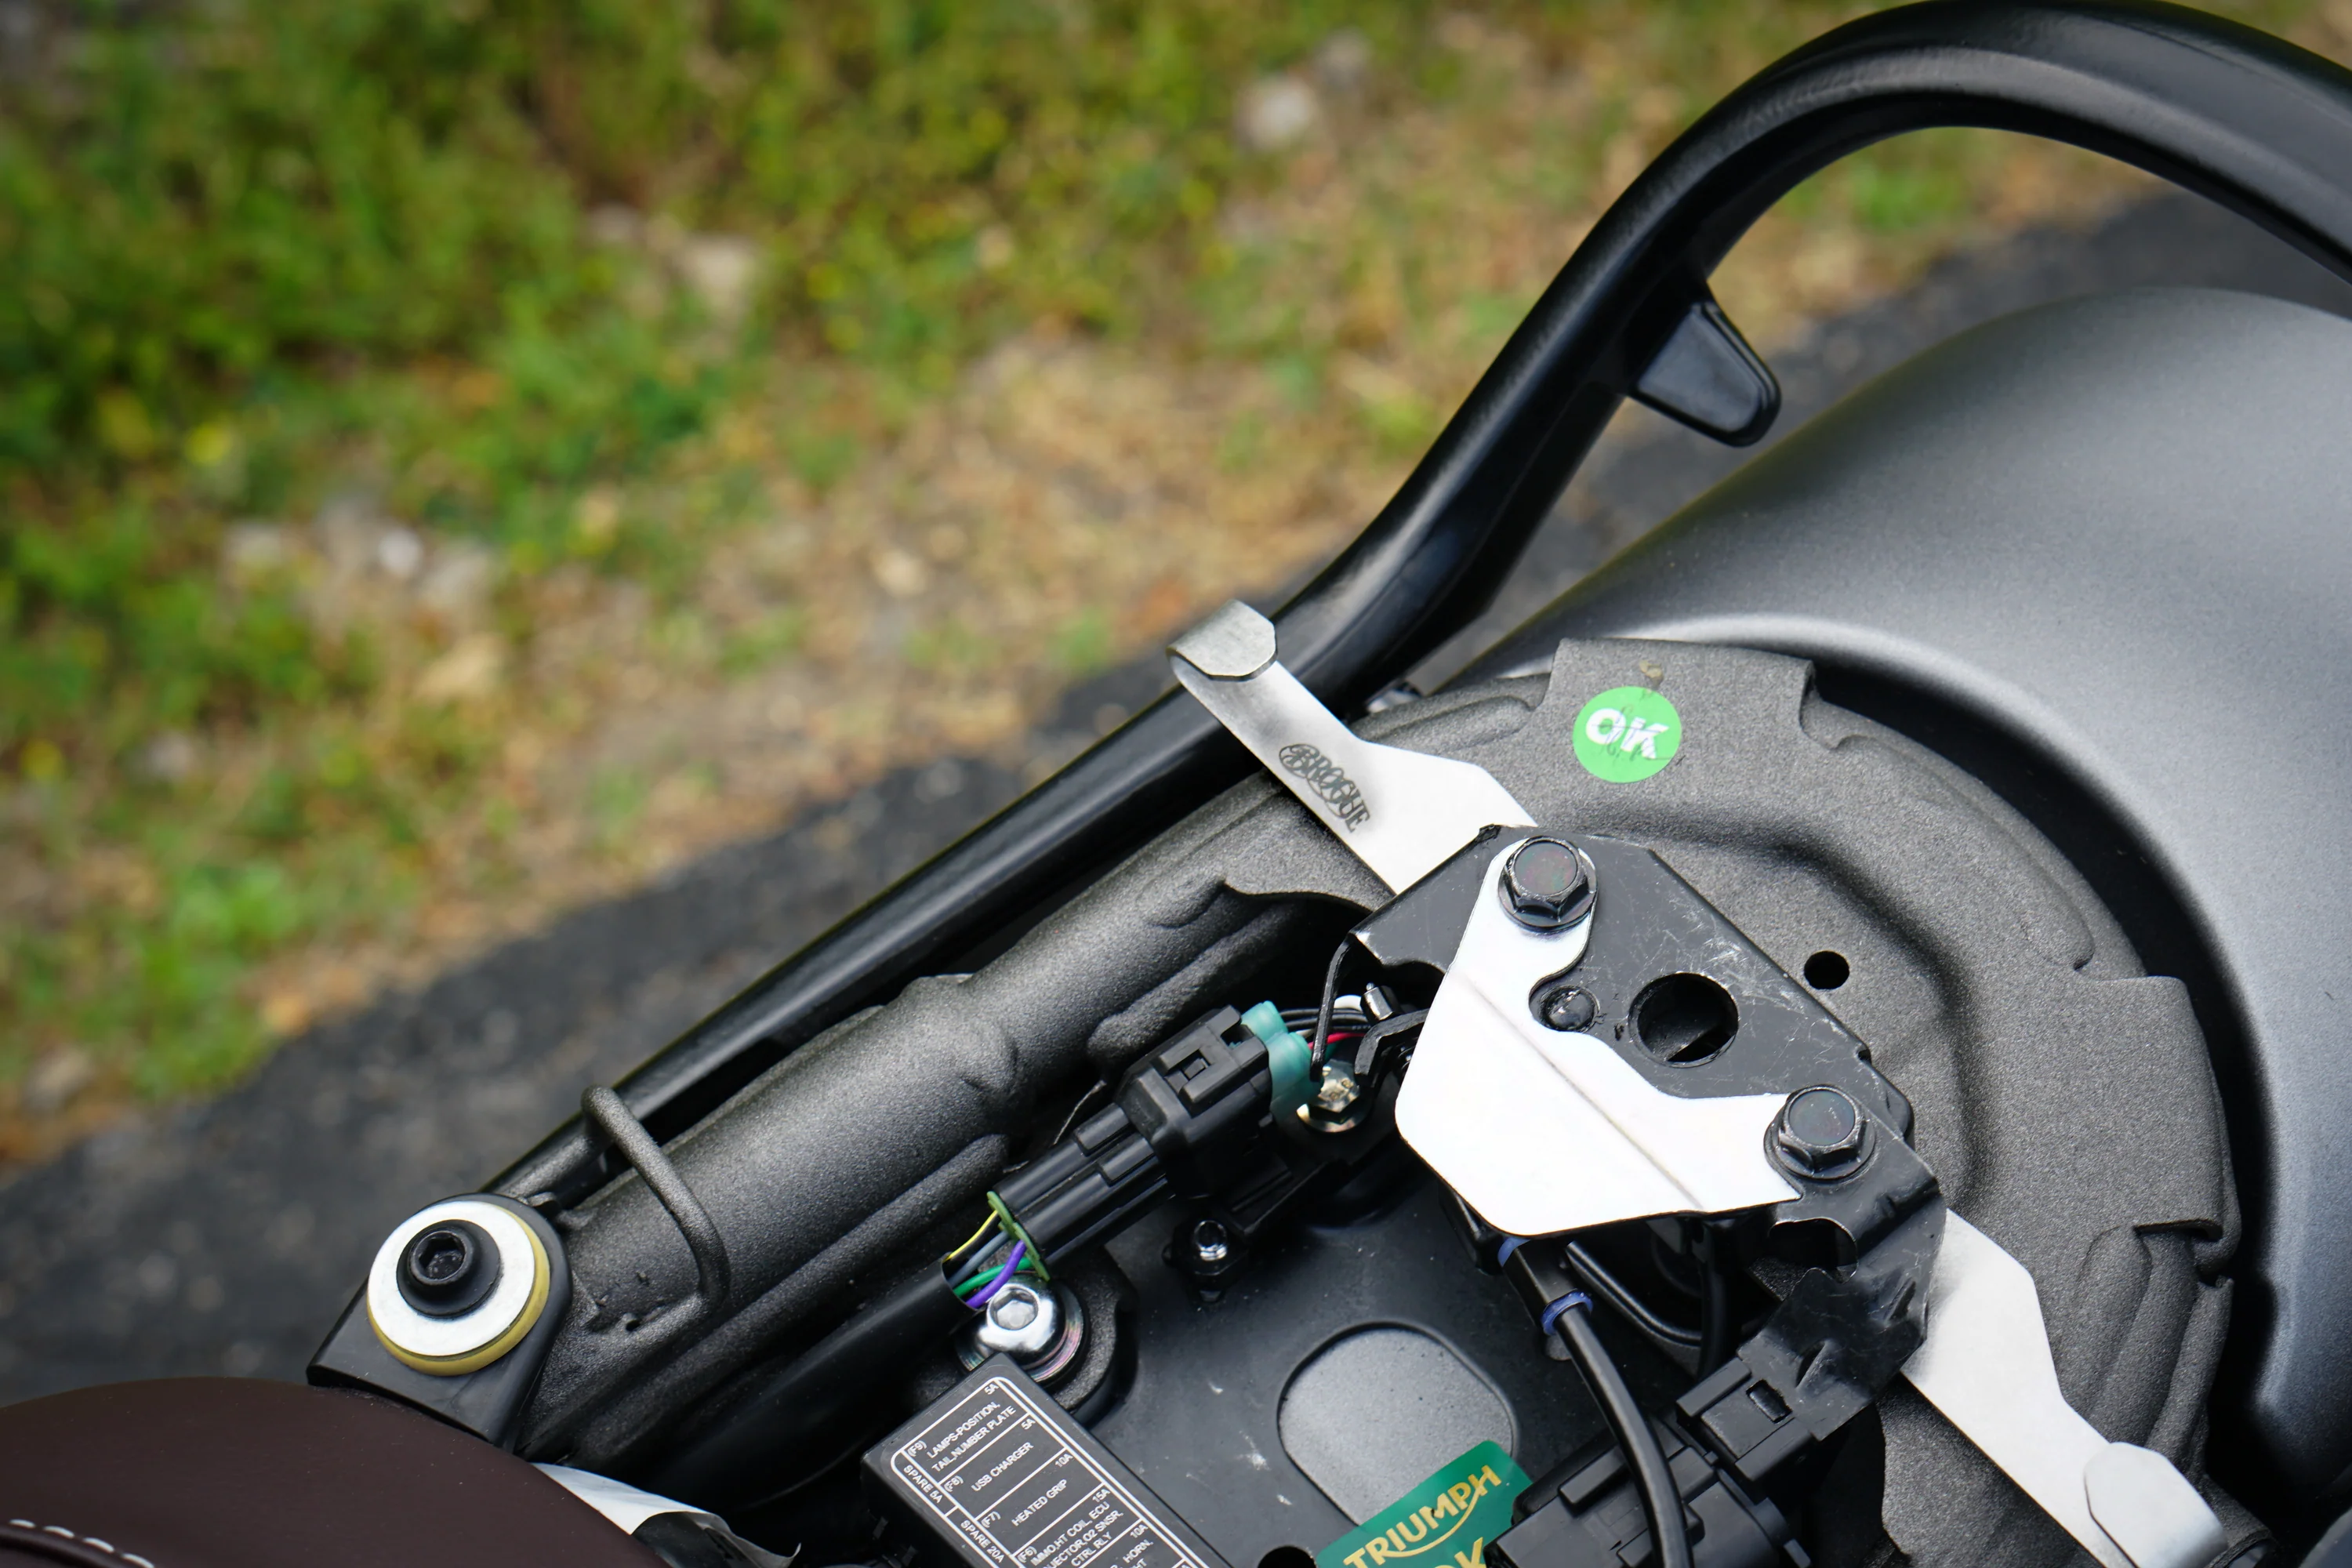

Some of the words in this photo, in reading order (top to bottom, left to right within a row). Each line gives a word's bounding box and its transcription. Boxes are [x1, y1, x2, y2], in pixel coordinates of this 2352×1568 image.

[1585, 708, 1670, 759] OK
[1279, 743, 1370, 833] BROGUE
[984, 1383, 999, 1396] 5A
[986, 1406, 1017, 1431] PLATE
[1021, 1418, 1036, 1430] 5A
[907, 1440, 927, 1457] (F9)
[971, 1474, 993, 1492] USB
[989, 1442, 1034, 1477] CHARGER
[1054, 1453, 1074, 1468] 10A
[903, 1465, 934, 1493] SPARE
[943, 1475, 964, 1493] (F8)
[1011, 1496, 1048, 1526] HEATED
[1046, 1479, 1067, 1498] GRIP
[1092, 1489, 1111, 1503] 15A
[1088, 1501, 1110, 1519] ECU
[1342, 1465, 1502, 1568] TRIUMPH
[981, 1511, 1001, 1528] (F7)
[1130, 1524, 1149, 1539] 10A
[960, 1519, 991, 1548] SPARE
[986, 1545, 1005, 1563] 20A
[1071, 1548, 1097, 1566] CTRL
[1093, 1531, 1112, 1549] RLY
[1017, 1546, 1037, 1563] (F6)
